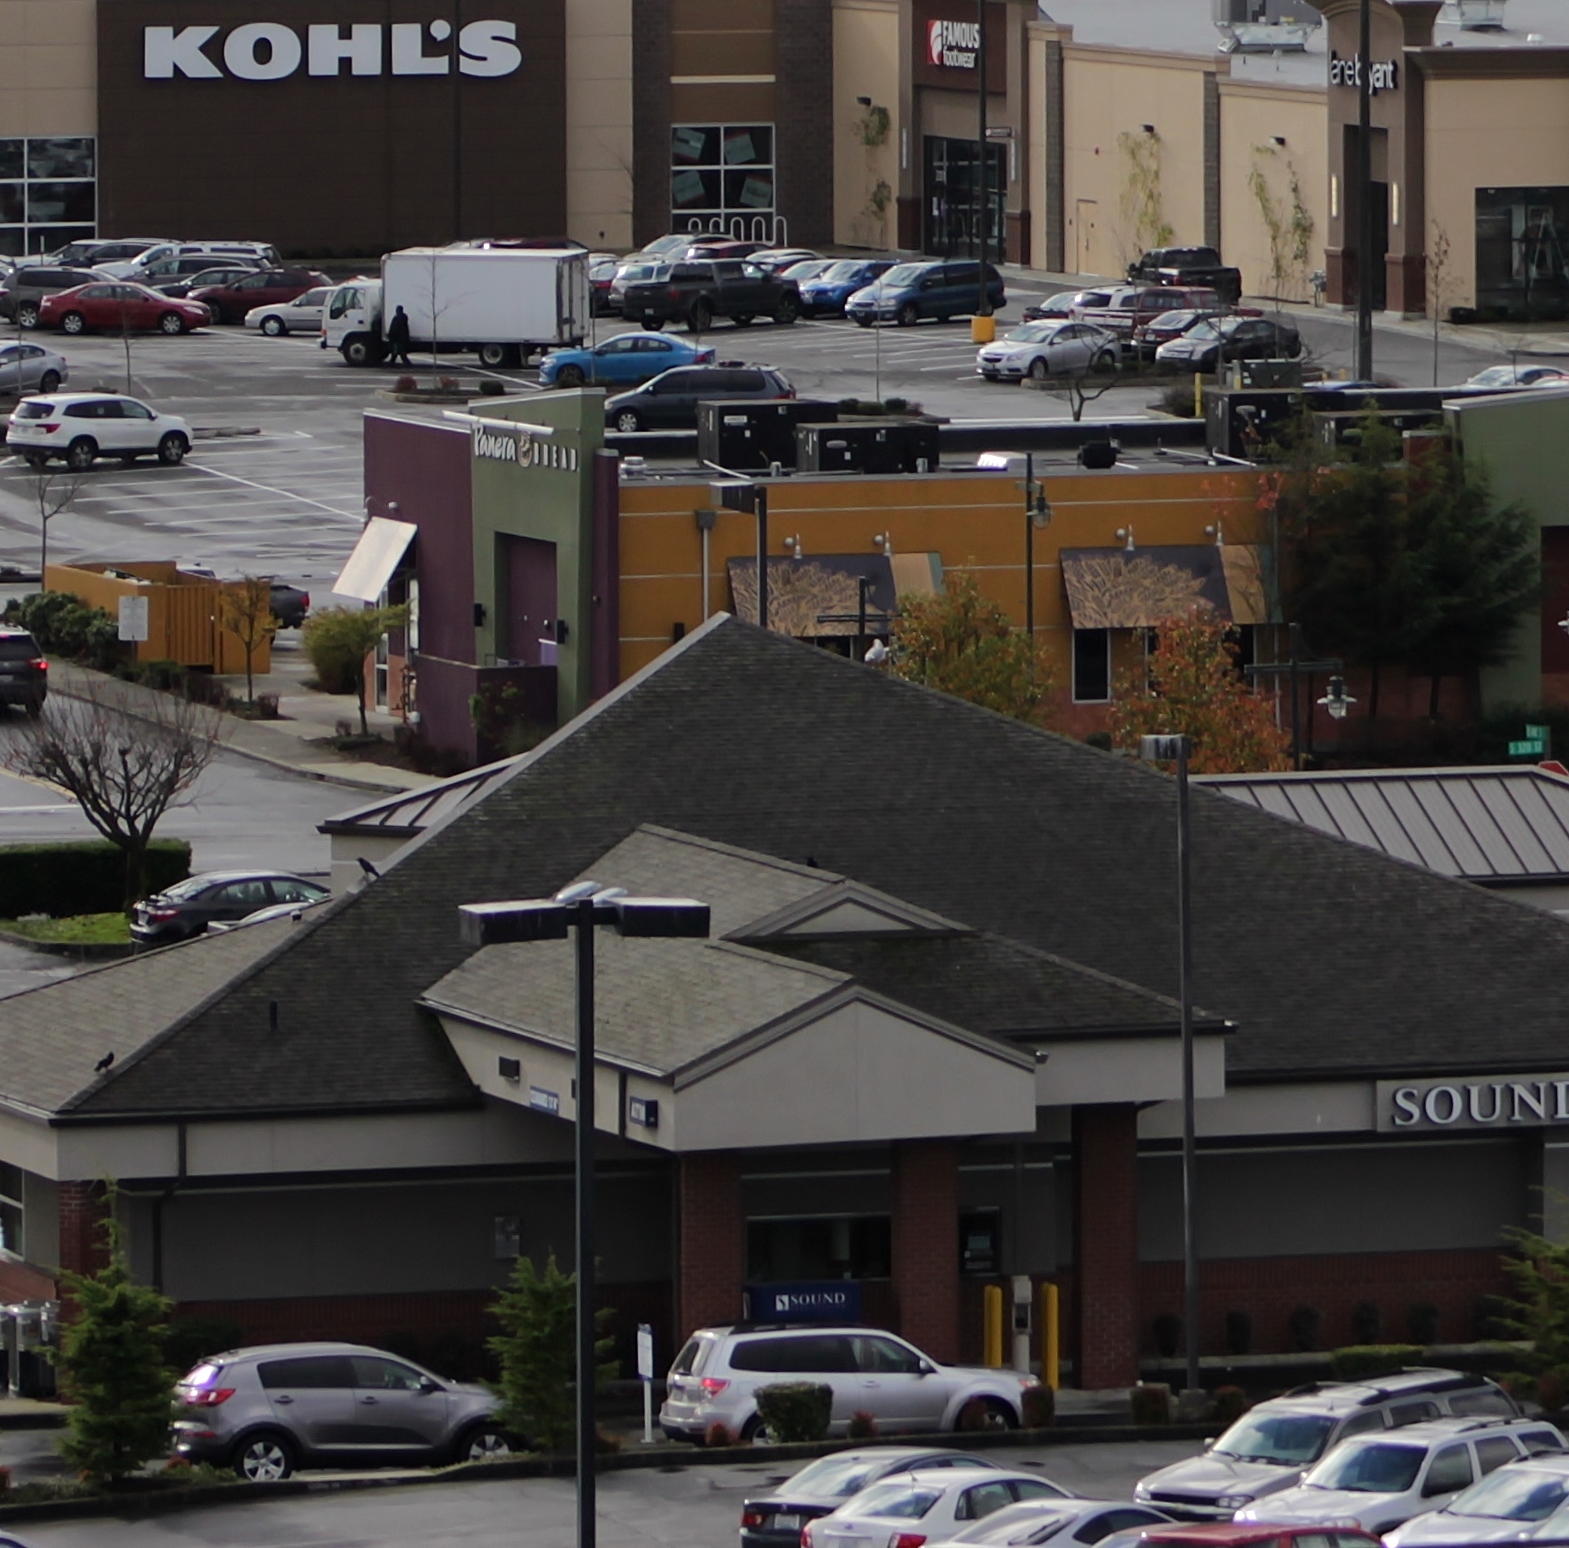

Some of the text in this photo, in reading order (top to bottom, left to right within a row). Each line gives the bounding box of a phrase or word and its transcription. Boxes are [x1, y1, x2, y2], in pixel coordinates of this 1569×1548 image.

[144, 19, 522, 80] KOHL'S
[943, 21, 980, 49] FAMOUS
[1355, 52, 1395, 95] byant
[473, 423, 517, 461] Panera
[790, 1292, 846, 1305] SOUND
